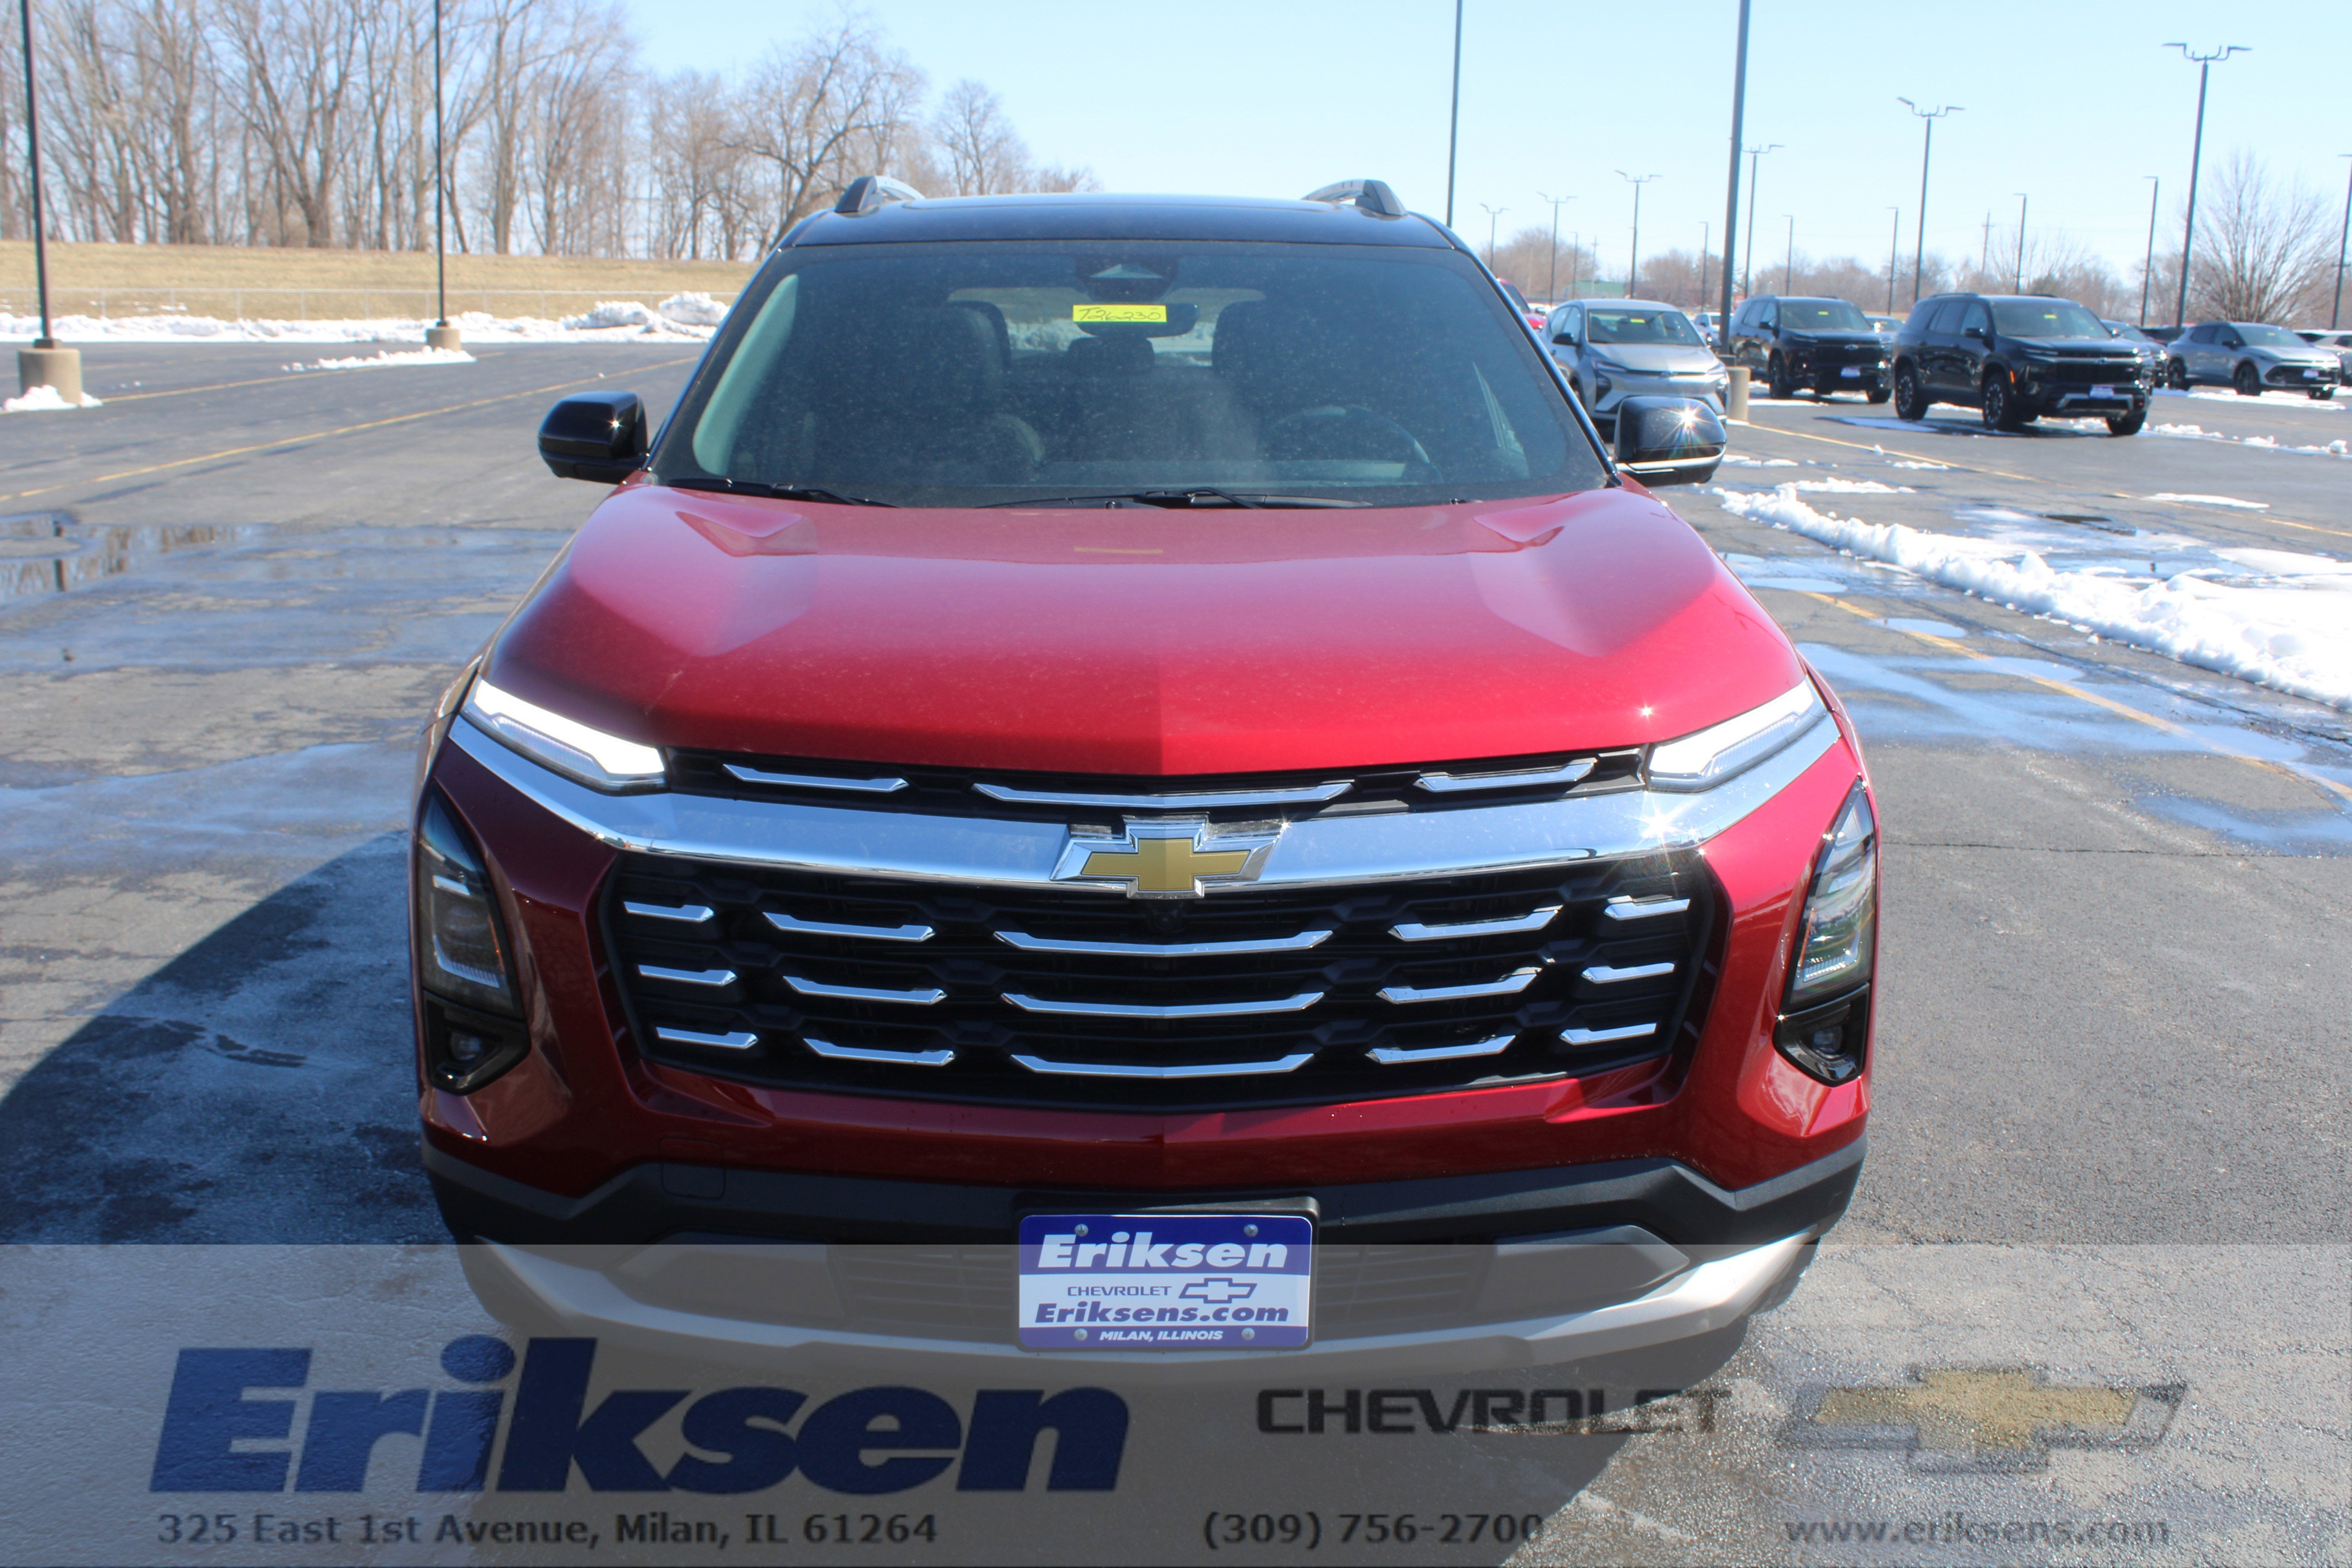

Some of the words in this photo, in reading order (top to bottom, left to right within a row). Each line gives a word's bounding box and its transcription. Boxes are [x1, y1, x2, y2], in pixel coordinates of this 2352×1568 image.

[1038, 1231, 1288, 1268] Eriksen
[1067, 1285, 1172, 1296] CHEVROLET
[1035, 1301, 1289, 1323] Eriksens.com
[1099, 1330, 1153, 1342] MILAN,
[1157, 1330, 1223, 1341] ILLINOIS
